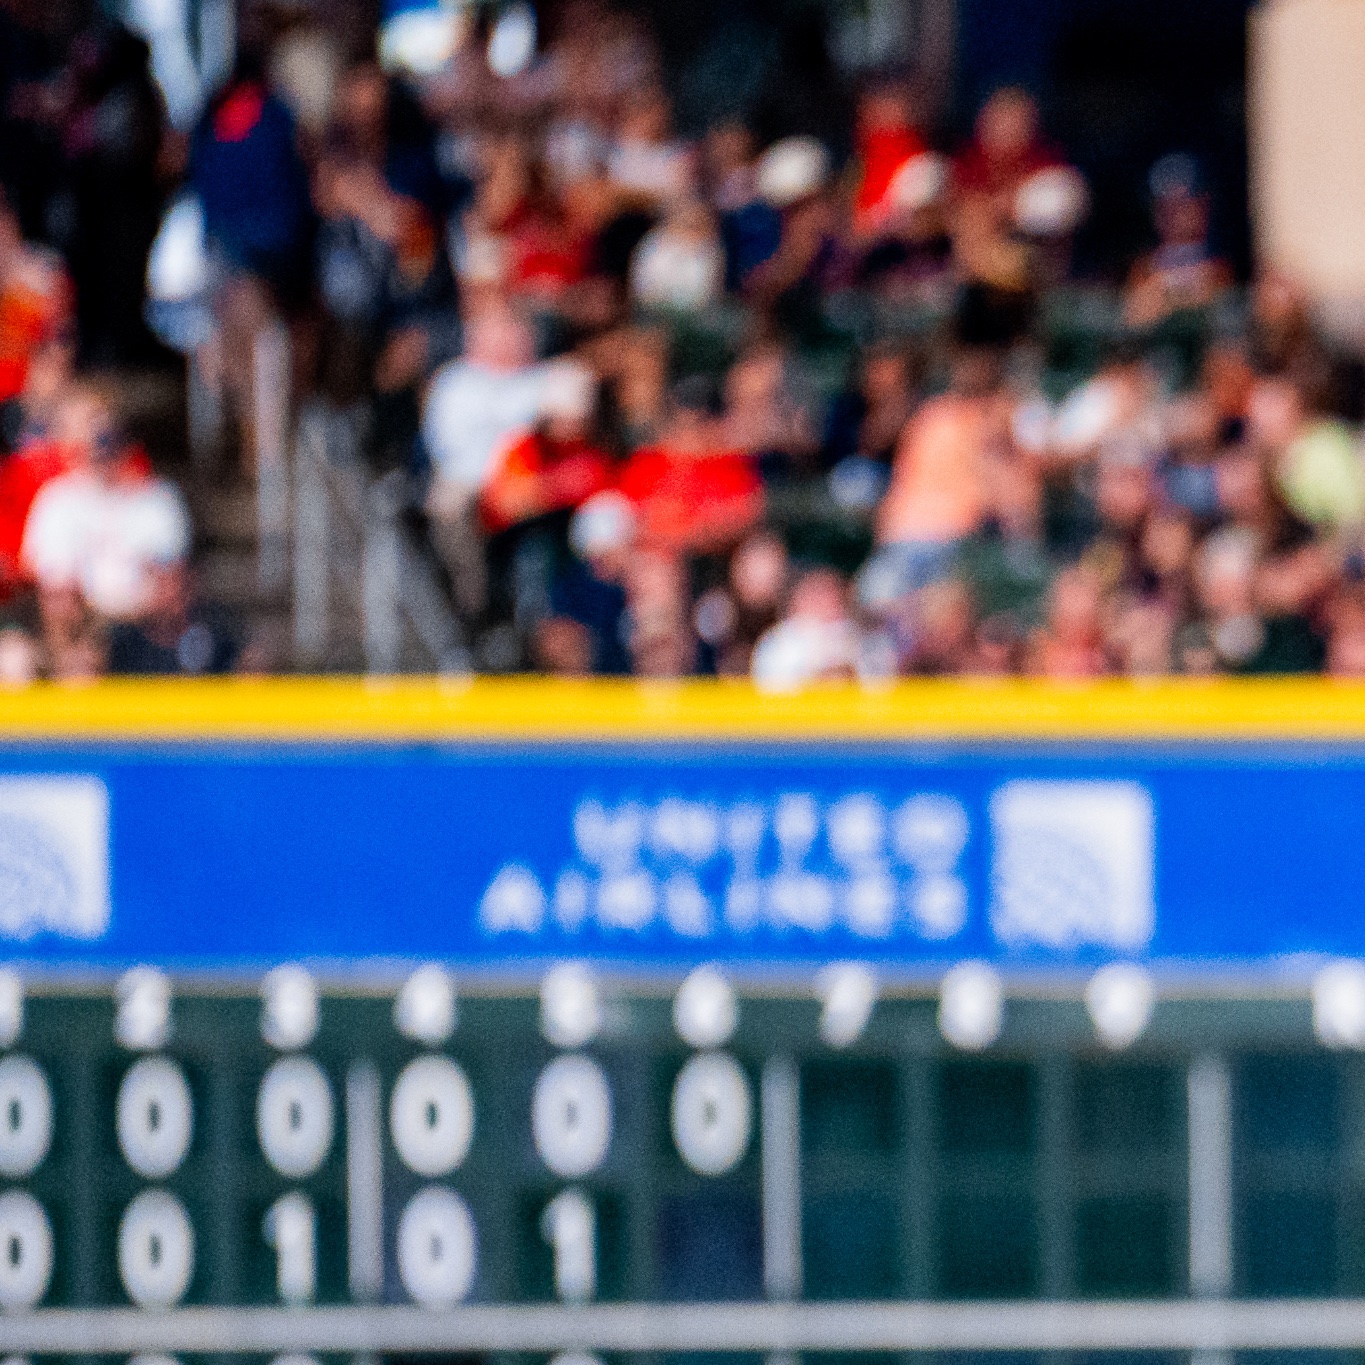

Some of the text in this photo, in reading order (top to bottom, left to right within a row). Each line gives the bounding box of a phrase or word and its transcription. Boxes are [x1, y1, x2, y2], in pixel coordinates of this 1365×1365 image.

[116, 1053, 193, 1178] 0
[256, 1053, 334, 1178] 0
[390, 1053, 475, 1178] 0
[531, 1053, 613, 1178] 0
[671, 1053, 752, 1178] 0
[117, 1188, 195, 1310] 0
[263, 1190, 317, 1308] 1
[400, 1187, 477, 1308] 0
[540, 1190, 596, 1306] 1
